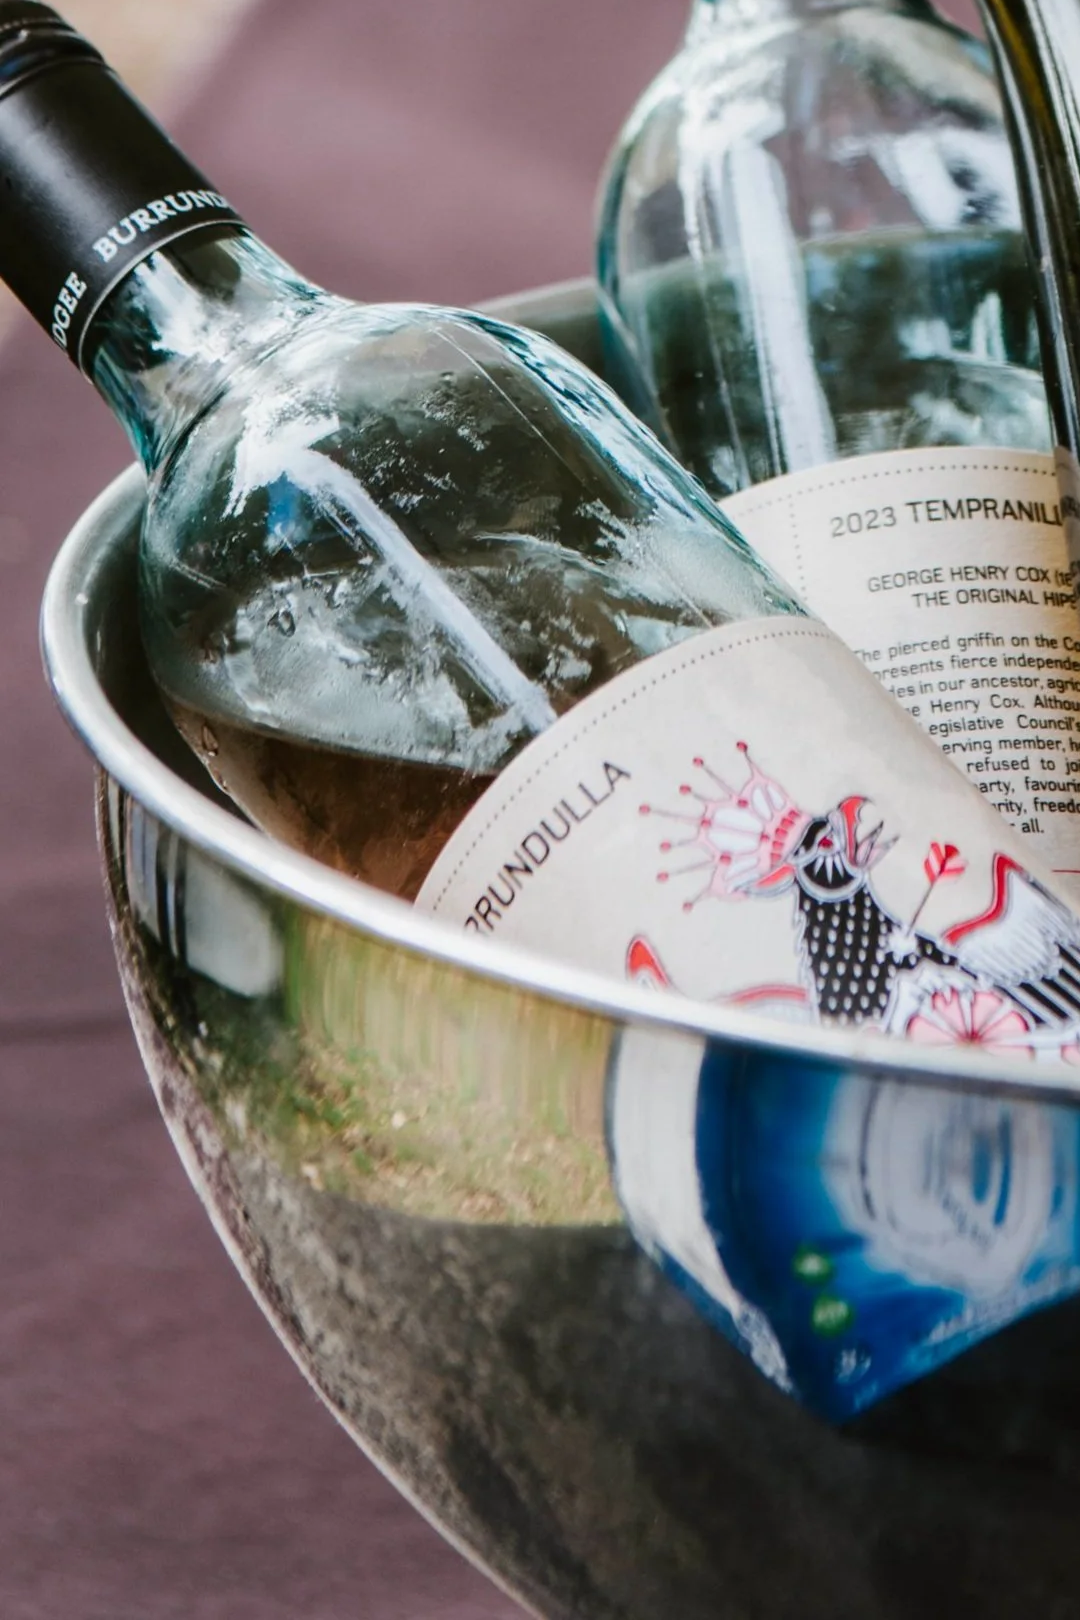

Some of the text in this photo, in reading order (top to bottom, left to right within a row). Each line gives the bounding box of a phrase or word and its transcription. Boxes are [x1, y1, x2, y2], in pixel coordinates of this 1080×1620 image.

[52, 189, 230, 349] DGEE BURRUND
[830, 498, 1064, 538] 2023 TEMPRANILL
[867, 567, 943, 593] GEORGE
[950, 565, 1009, 583] HENRY
[1015, 565, 1050, 582] COX
[912, 590, 950, 609] THE
[956, 587, 1039, 606] ORIGINAL
[888, 635, 950, 661] pierced
[957, 632, 1005, 652] griffin
[1011, 635, 1030, 648] on
[1034, 633, 1058, 650] the
[950, 654, 998, 669] fierce
[919, 680, 934, 695] in
[938, 678, 965, 692] our
[971, 675, 1045, 691] ancestor,
[930, 698, 980, 716] Henry
[990, 694, 1025, 710] Cox.
[929, 715, 1004, 738] egislative
[942, 736, 992, 755] erving
[998, 735, 1066, 754] member,
[966, 756, 1030, 774] refused
[1040, 757, 1056, 771] to
[1021, 818, 1045, 835] all.
